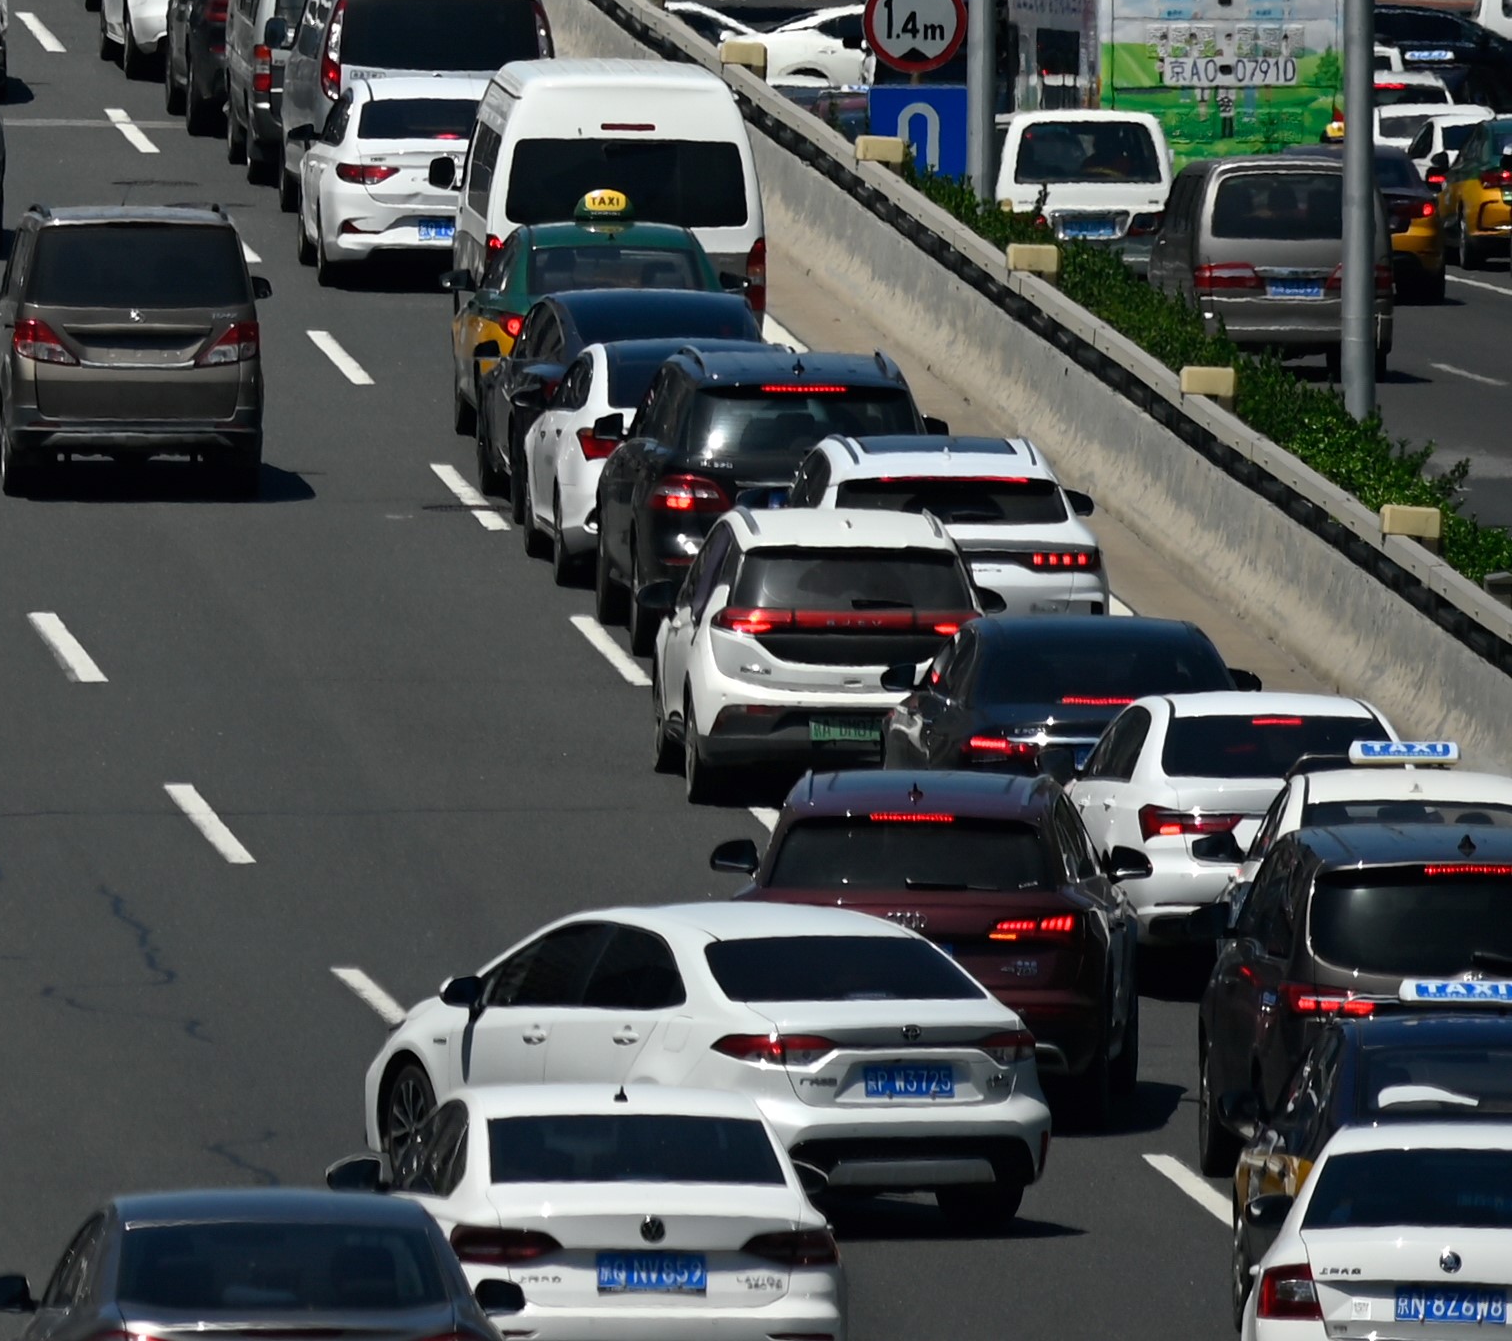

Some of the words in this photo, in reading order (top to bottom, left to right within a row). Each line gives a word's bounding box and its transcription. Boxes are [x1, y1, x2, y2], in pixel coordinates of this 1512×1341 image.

[591, 196, 620, 206] TAXI
[1369, 742, 1446, 755] TAXI
[1419, 982, 1511, 996] TAXI
